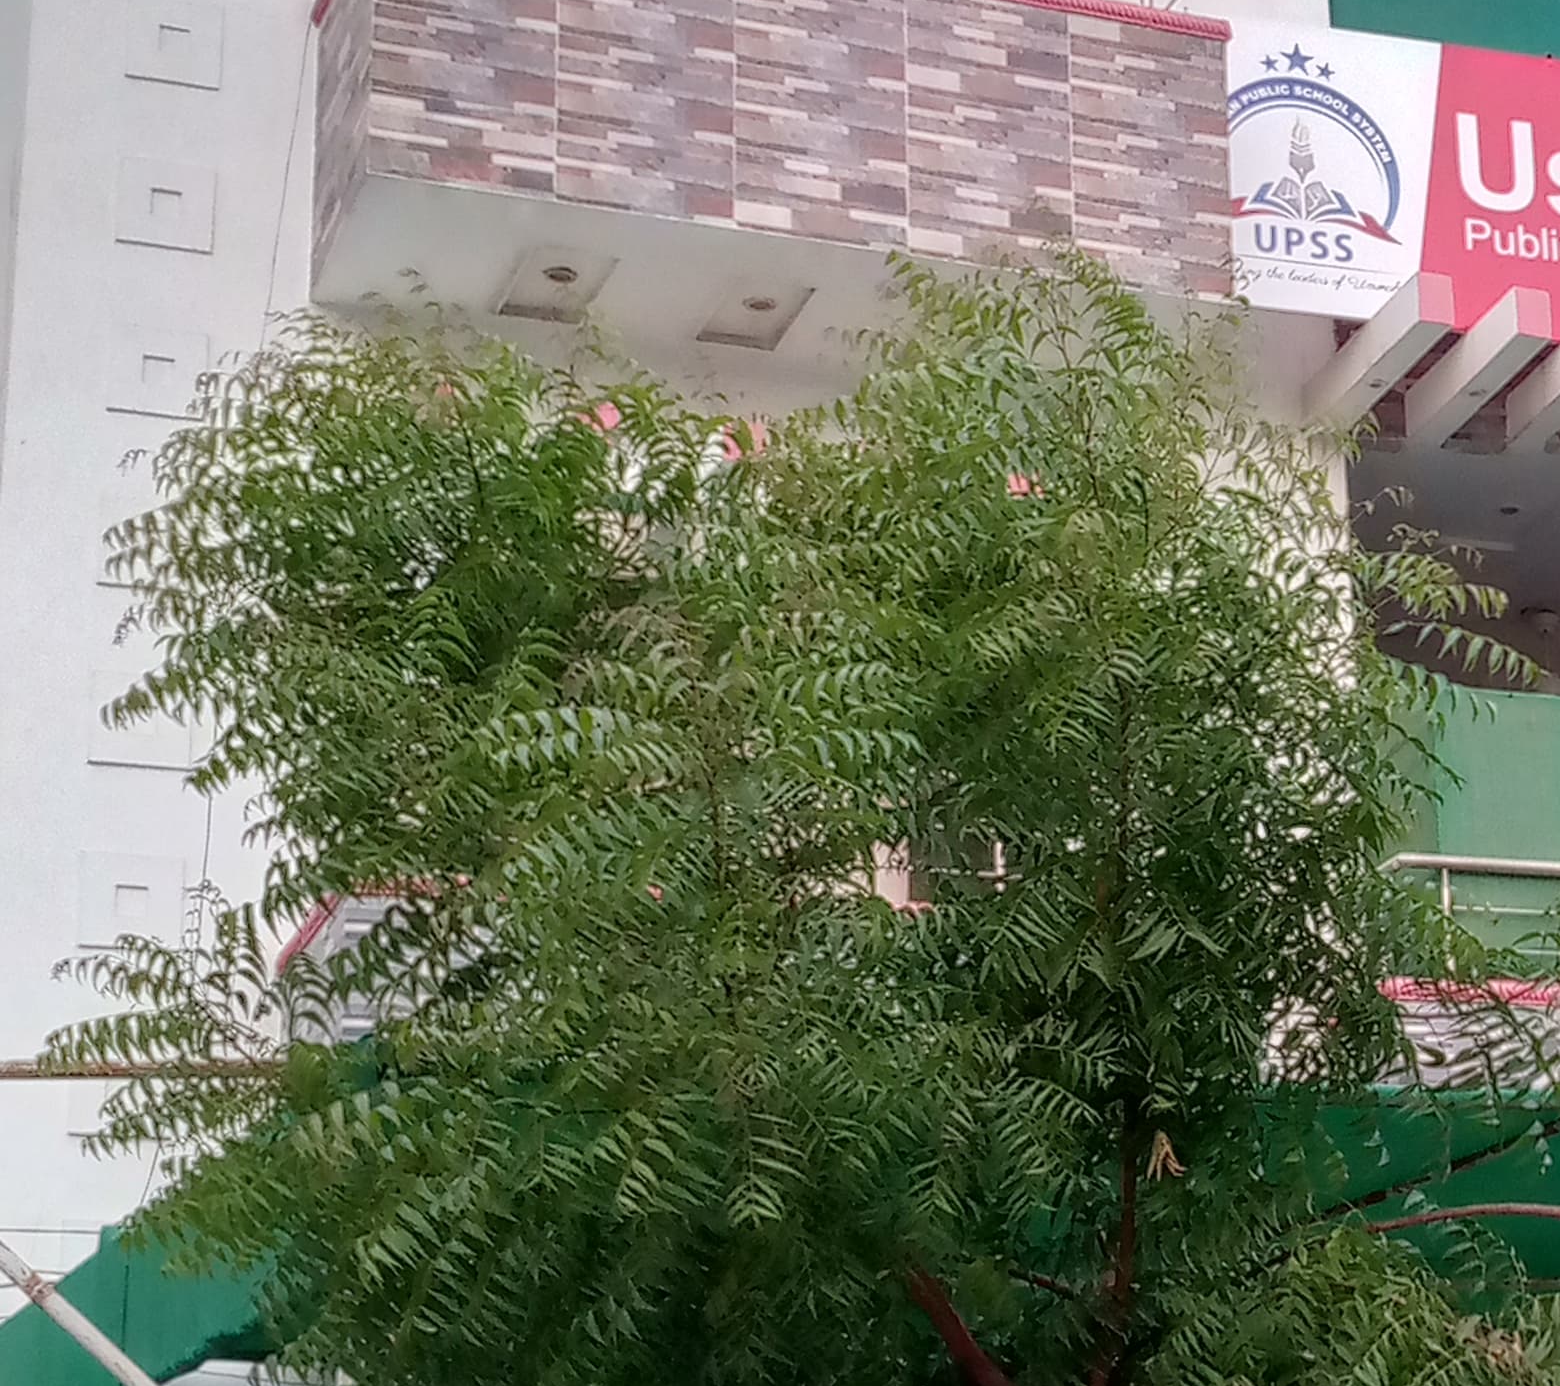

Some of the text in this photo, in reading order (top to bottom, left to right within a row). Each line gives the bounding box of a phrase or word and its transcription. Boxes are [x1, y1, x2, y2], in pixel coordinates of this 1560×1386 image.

[1242, 84, 1290, 105] PUBLIC
[1293, 85, 1351, 116] SCHOOL
[1253, 222, 1355, 263] UPSS
